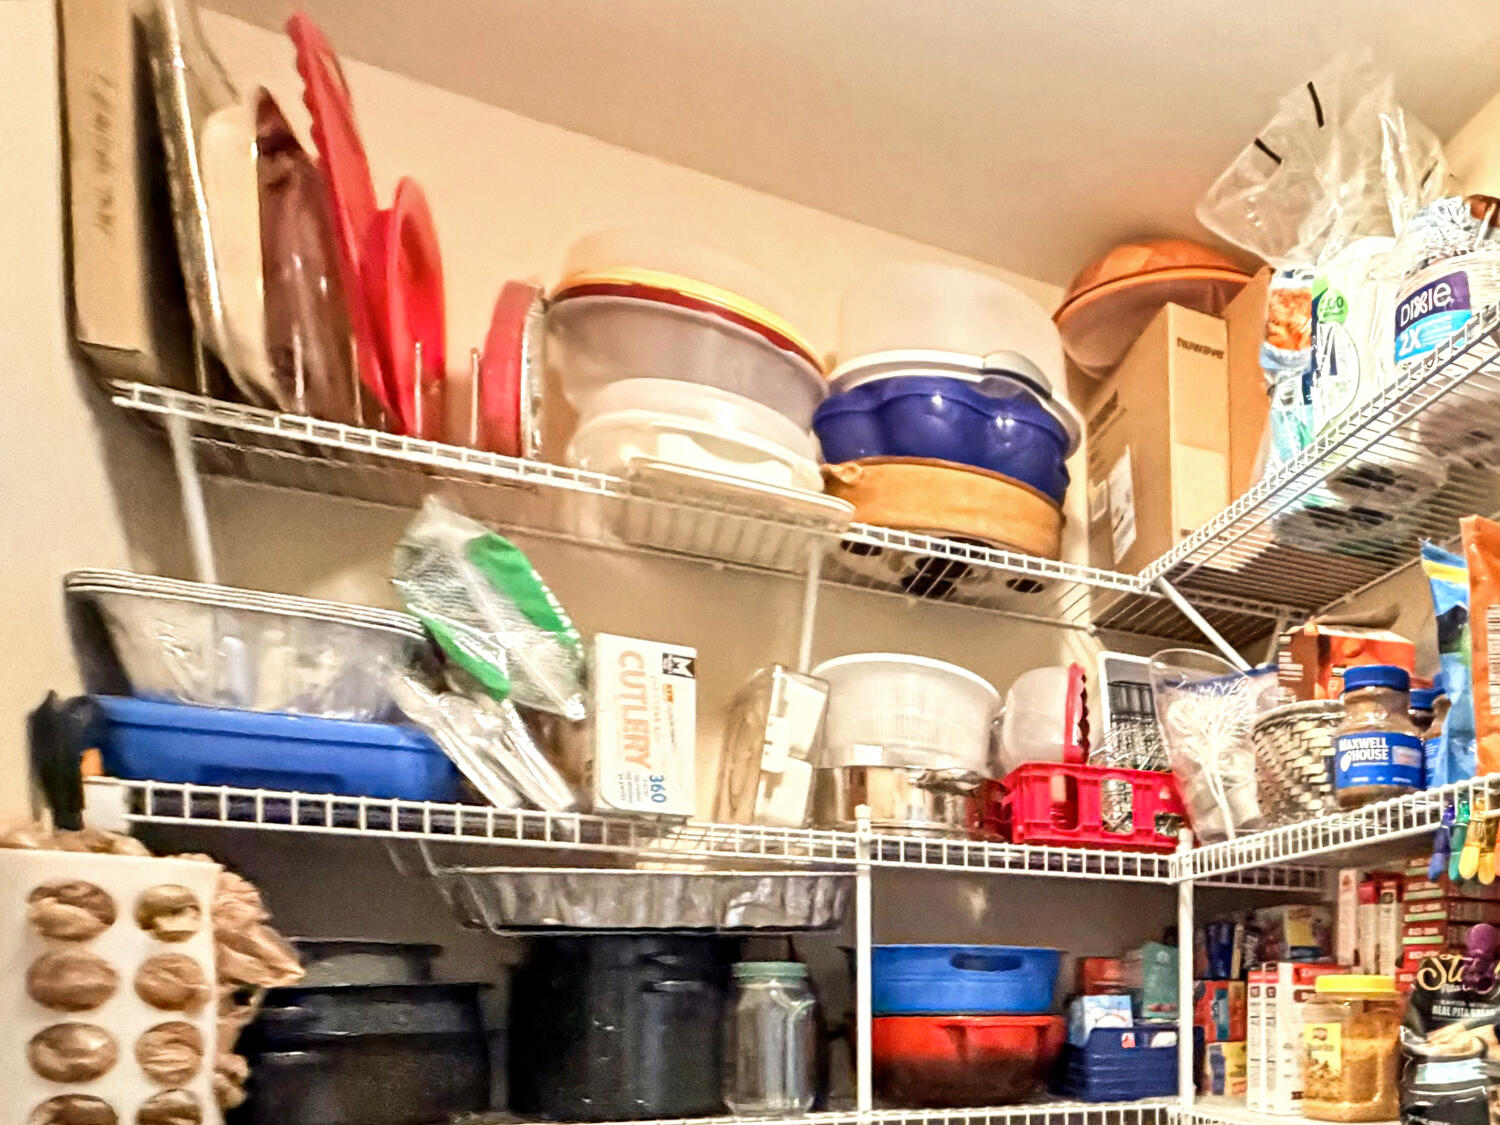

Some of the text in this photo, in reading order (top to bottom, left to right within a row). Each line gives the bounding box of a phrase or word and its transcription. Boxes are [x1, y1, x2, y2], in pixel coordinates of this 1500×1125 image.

[617, 650, 652, 770] CUTLERY
[1339, 737, 1389, 752] MAXWELL
[1351, 748, 1389, 761] HOUSE
[650, 774, 668, 804] 360
